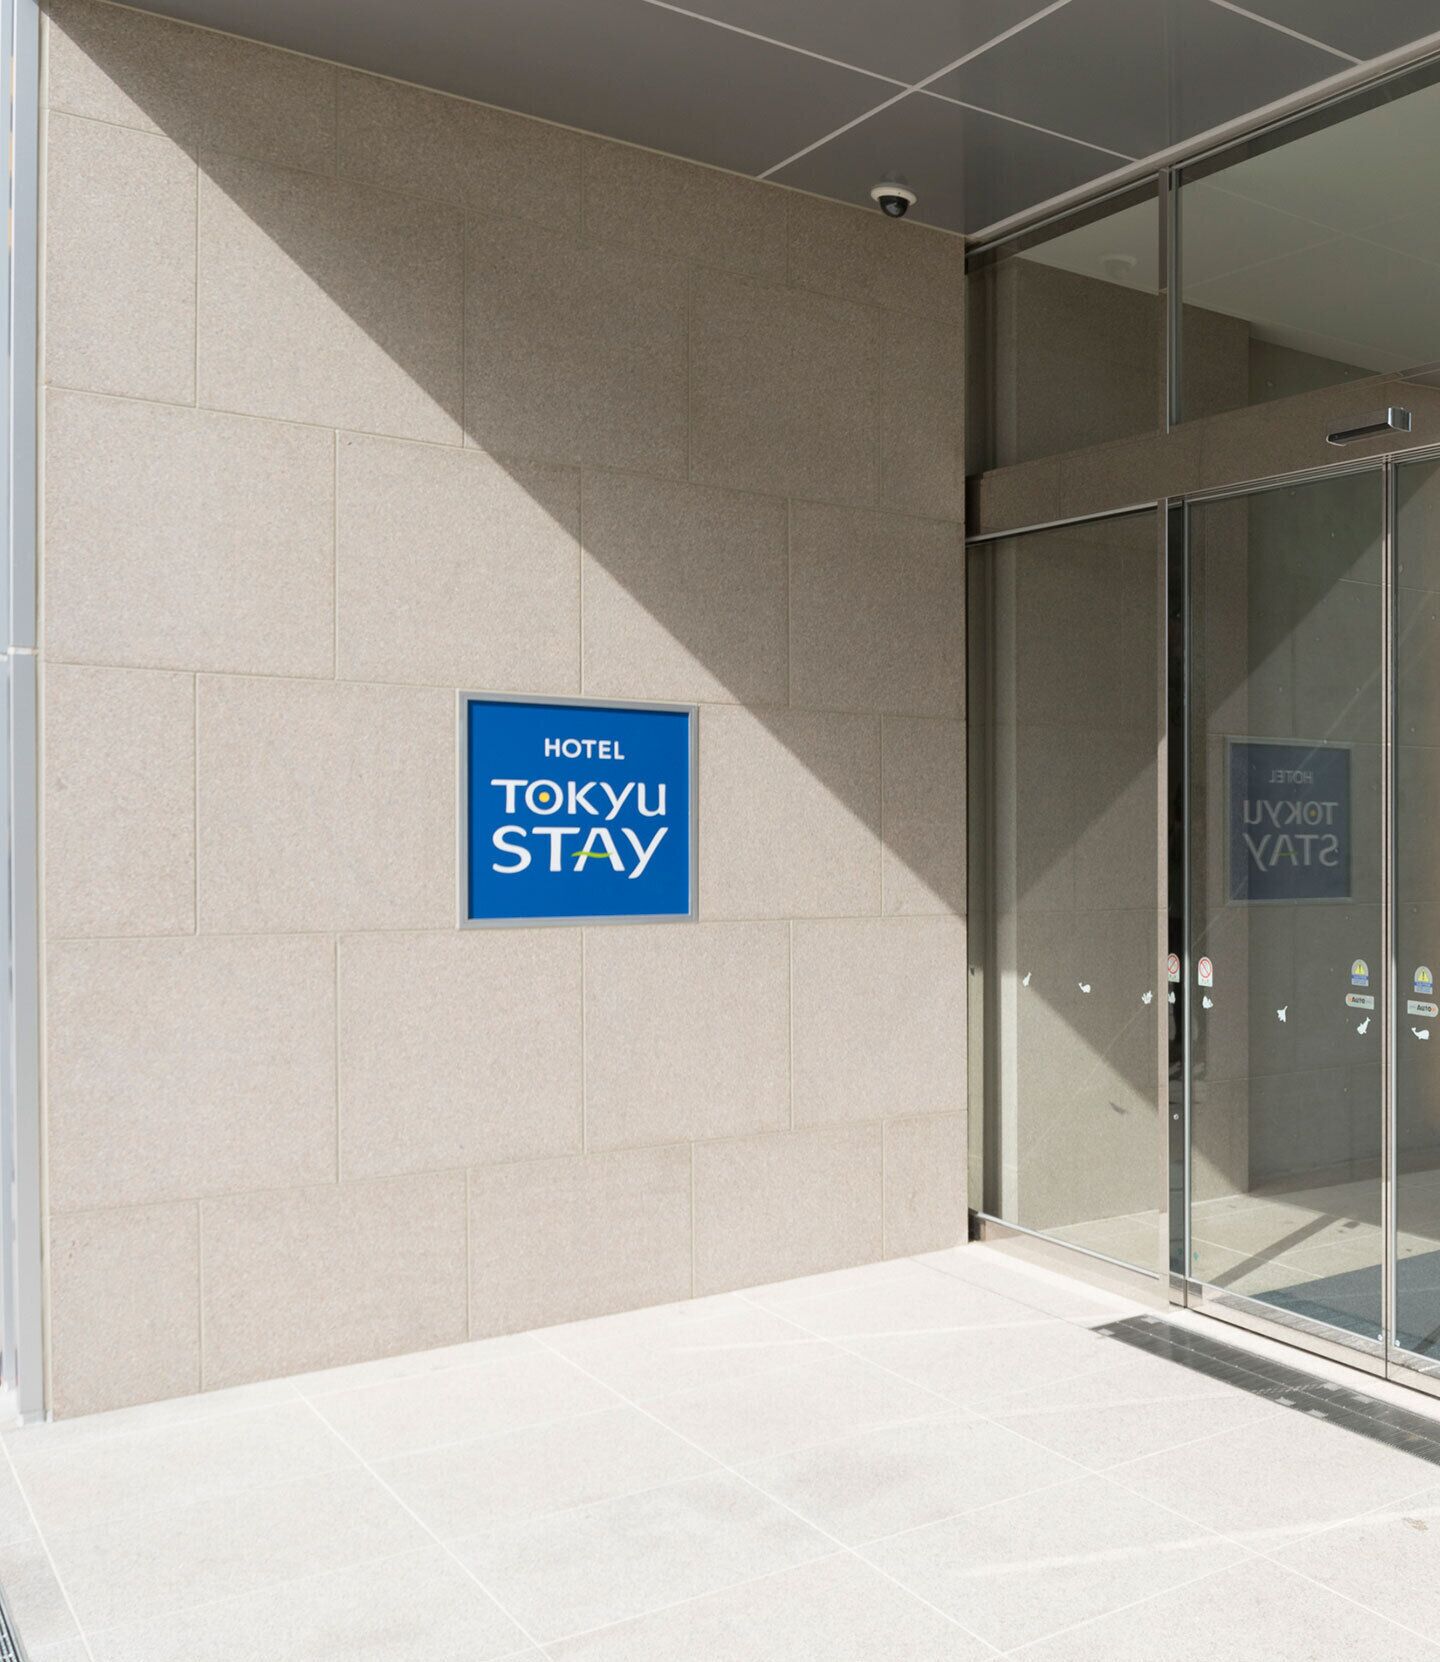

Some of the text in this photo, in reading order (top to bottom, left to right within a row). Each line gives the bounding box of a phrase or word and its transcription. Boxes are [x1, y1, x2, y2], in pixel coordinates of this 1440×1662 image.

[545, 738, 625, 760] HOTEL
[490, 779, 666, 821] TOKYU
[492, 825, 669, 879] STAY
